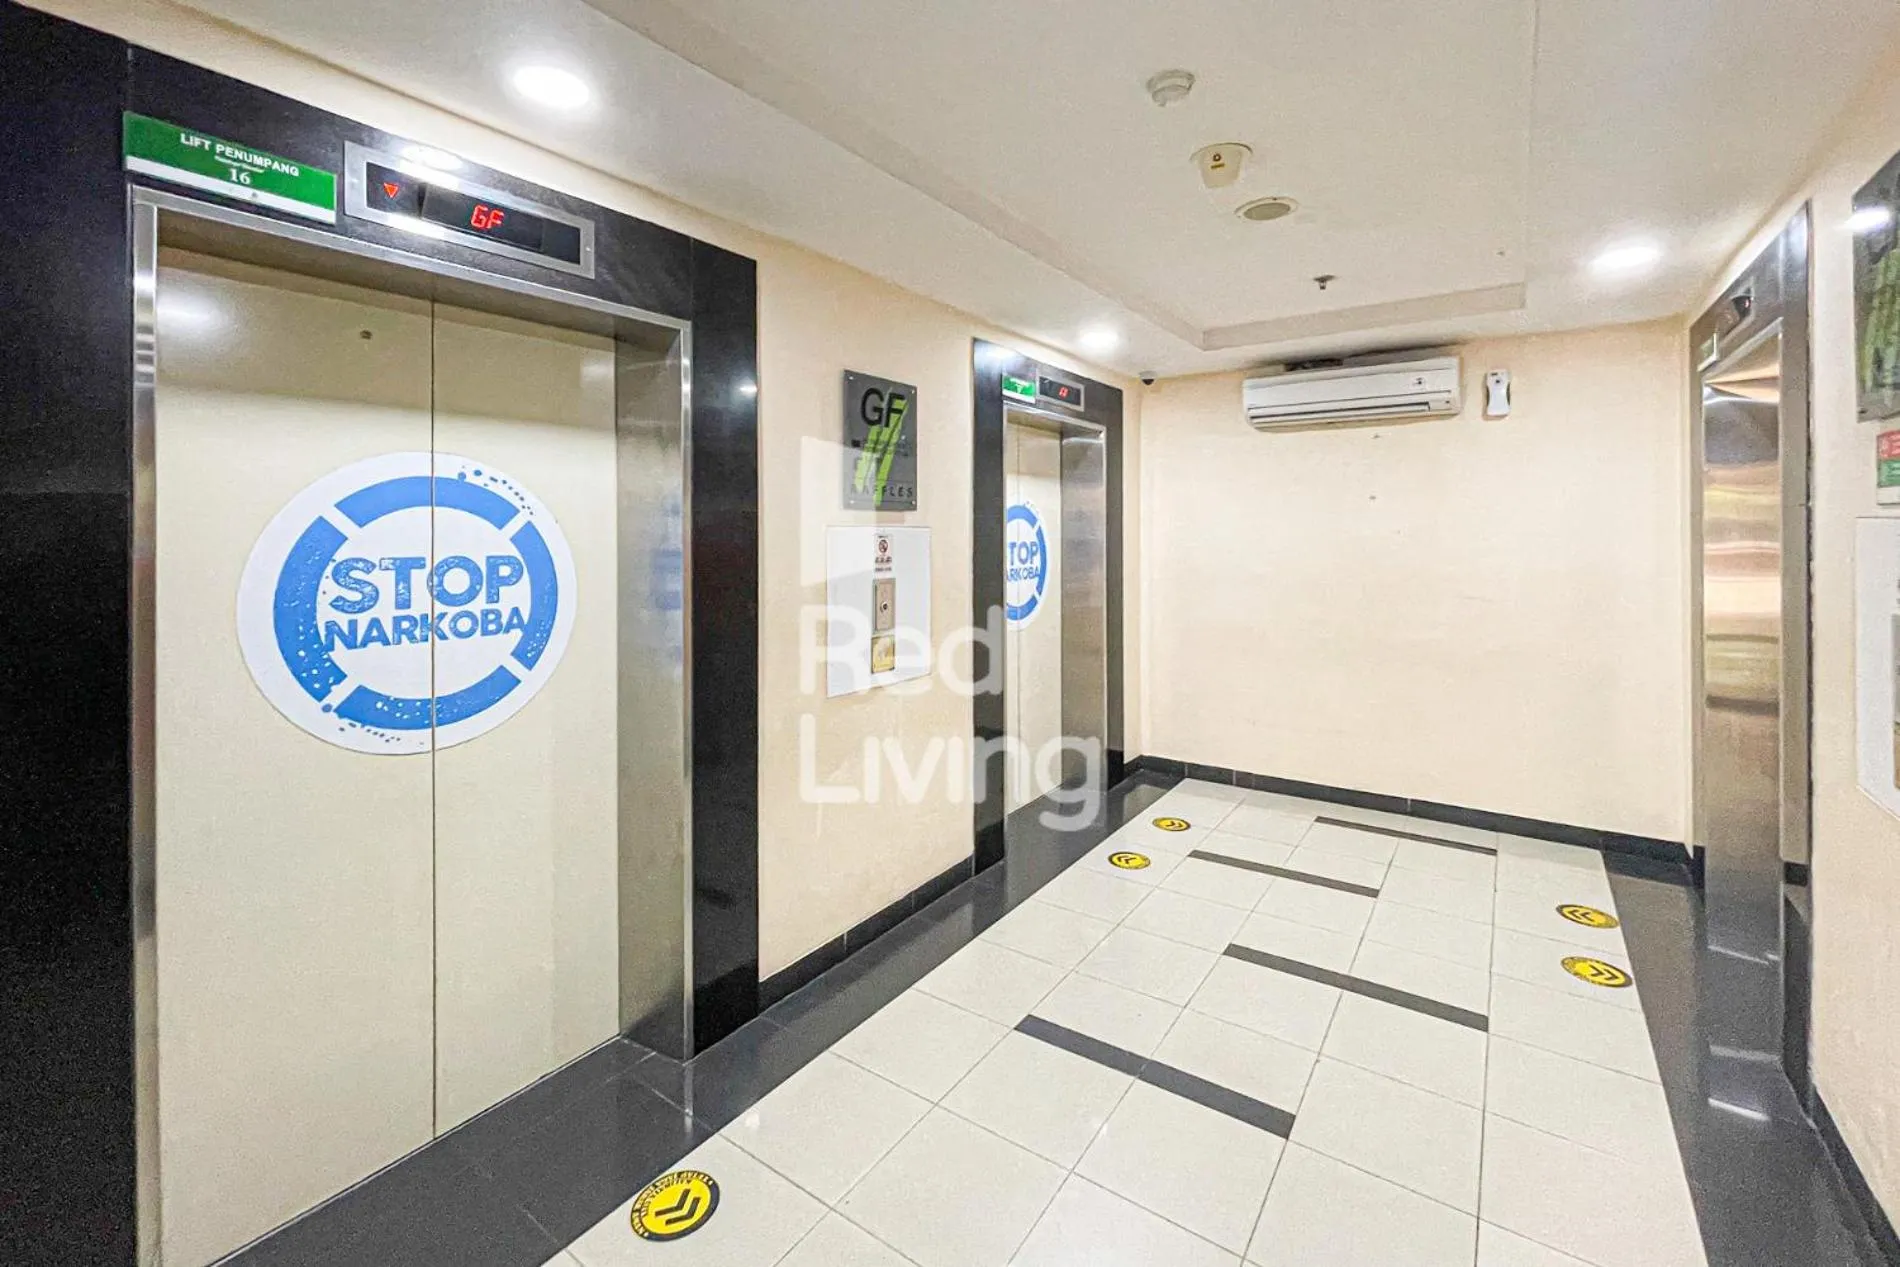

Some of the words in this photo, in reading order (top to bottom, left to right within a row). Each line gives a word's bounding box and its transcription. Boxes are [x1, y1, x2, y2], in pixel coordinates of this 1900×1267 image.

[180, 133, 212, 151] LIFT
[215, 144, 300, 177] PENUMPANG
[228, 168, 250, 185] 16
[471, 204, 505, 229] GF
[861, 387, 906, 428] GF
[1008, 541, 1039, 566] TOP
[329, 555, 524, 615] STOP
[1006, 566, 1040, 582] RKOBA
[323, 606, 527, 652] NARKOBA
